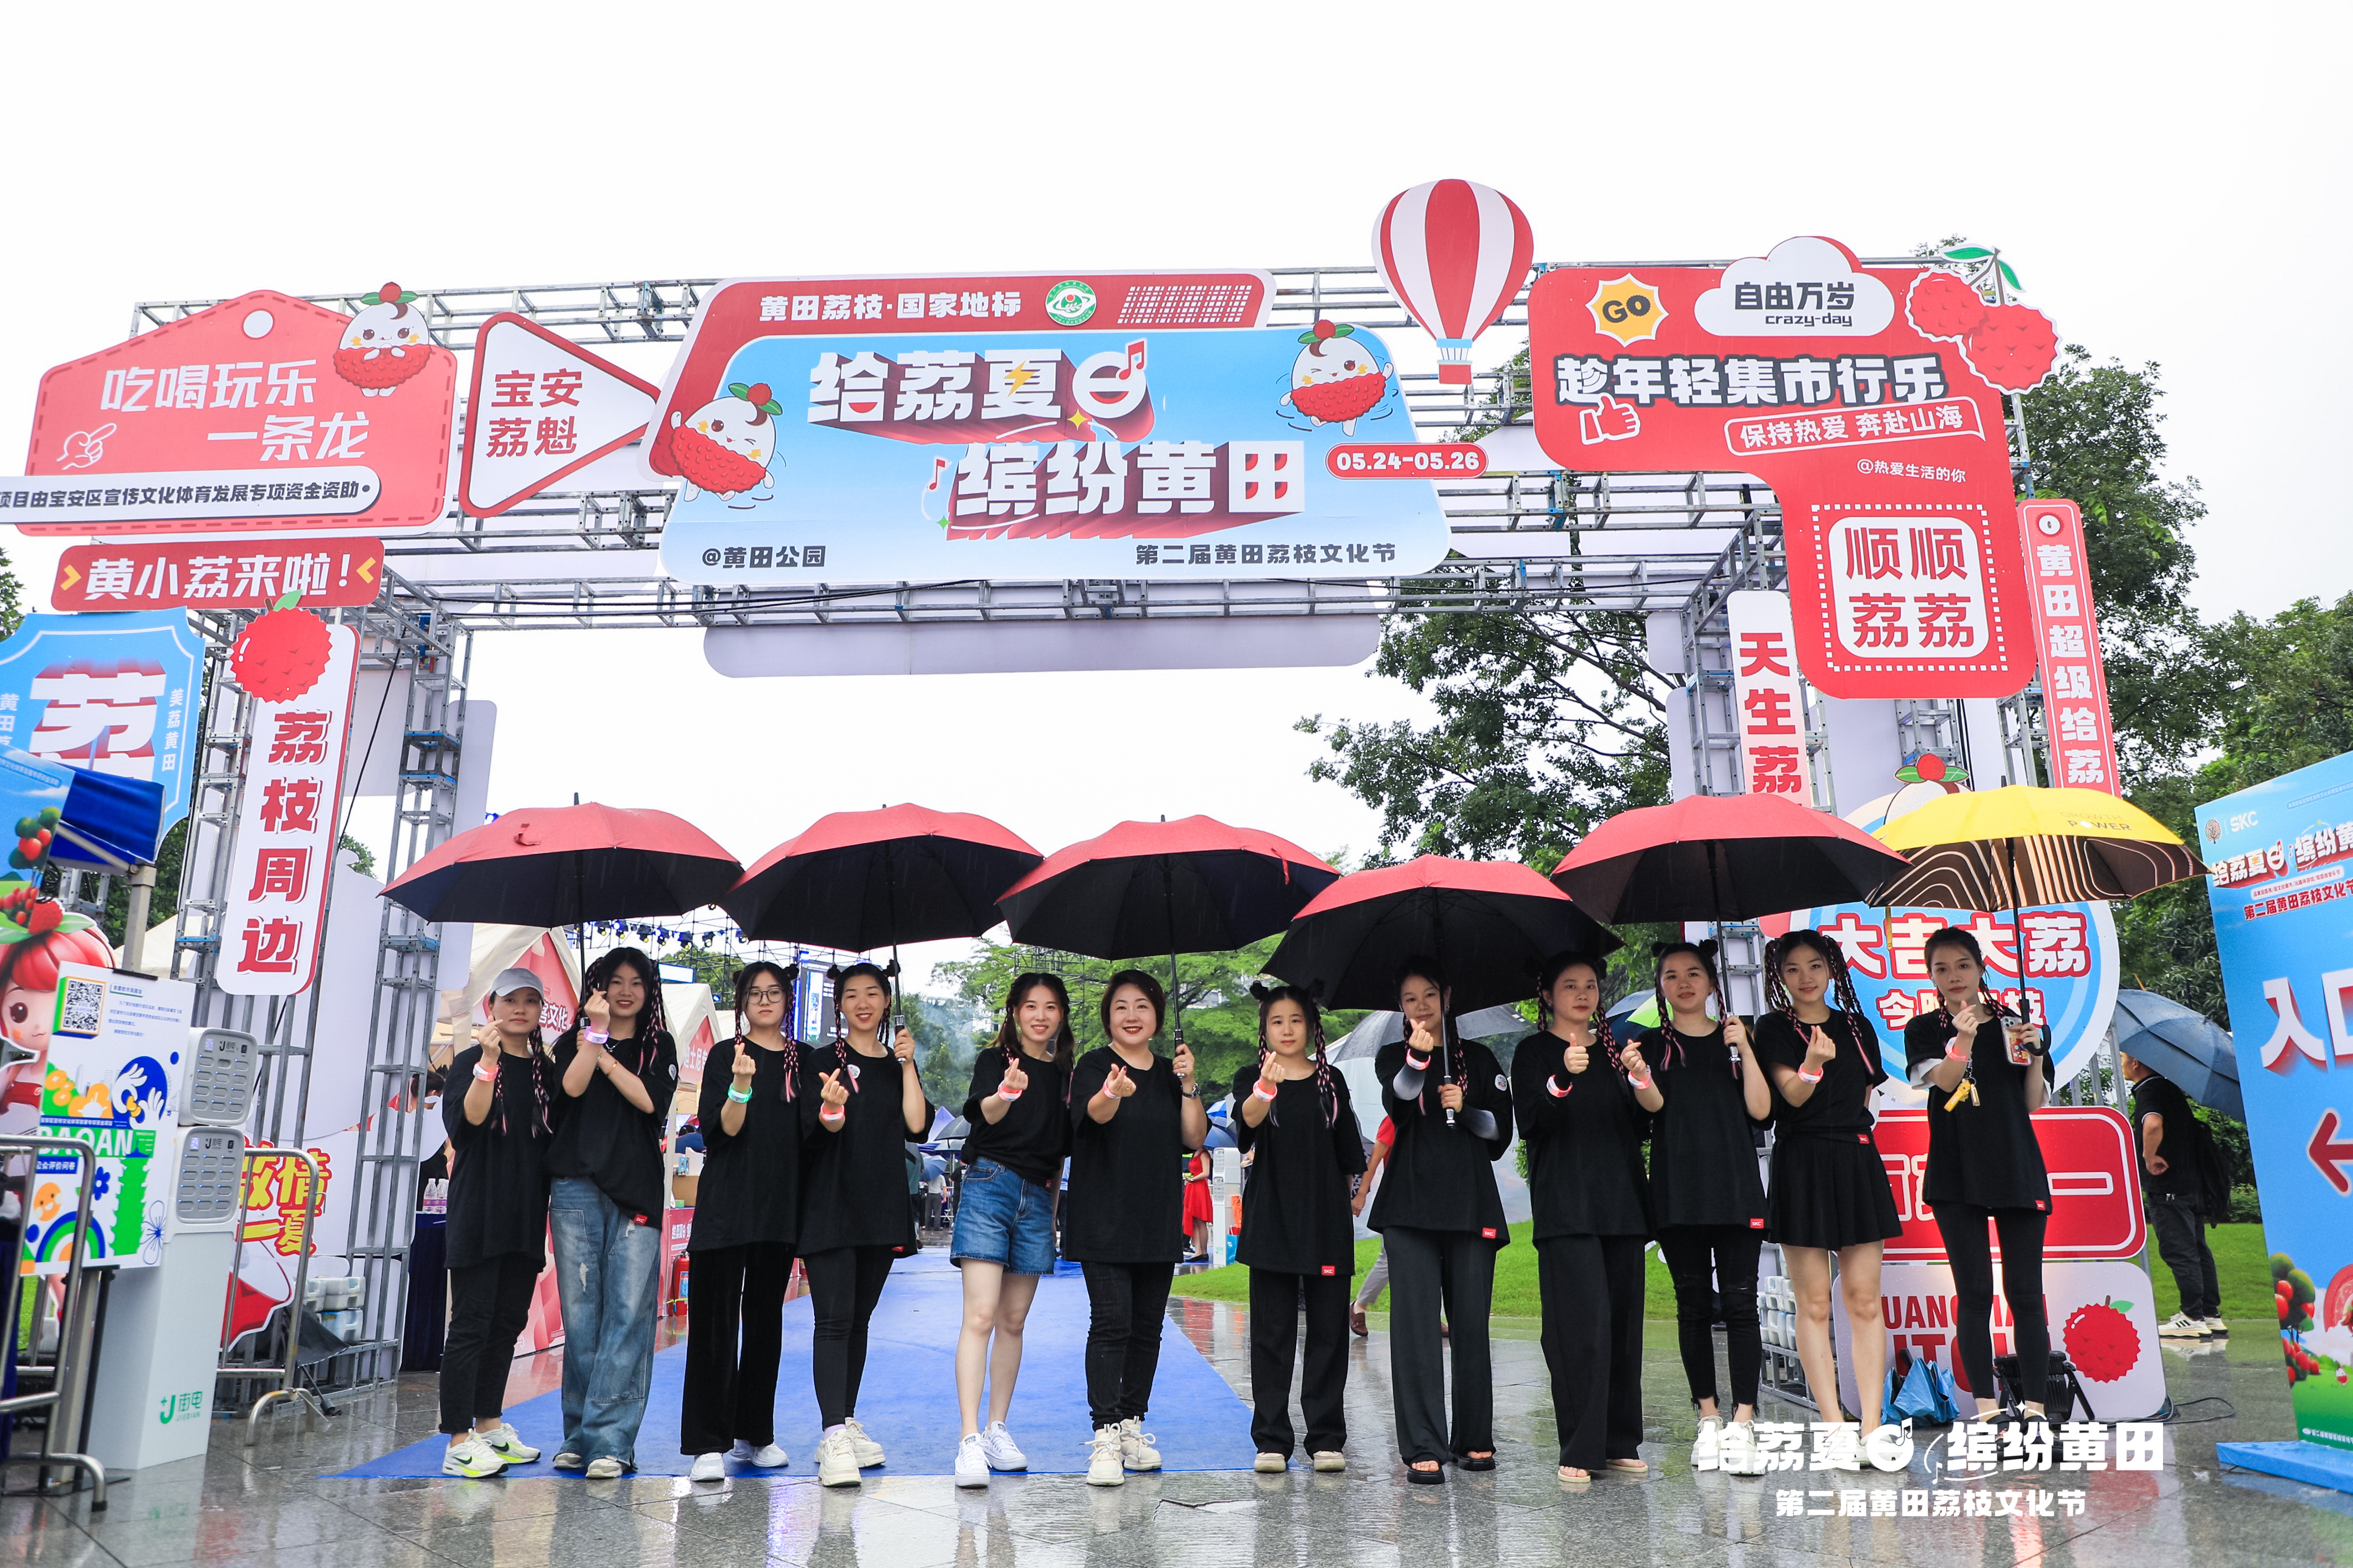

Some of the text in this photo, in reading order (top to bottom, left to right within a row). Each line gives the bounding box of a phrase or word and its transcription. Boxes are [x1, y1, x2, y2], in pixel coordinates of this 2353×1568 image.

[759, 291, 1022, 322] 黄田荔枝·国家地标
[1602, 295, 1651, 323] GO
[1735, 282, 1855, 311] 自由万岁
[1765, 313, 1852, 327] crazy-day
[100, 359, 317, 412] 吃喝玩乐
[491, 368, 583, 408] 宝安
[1557, 355, 1947, 405] 趁年轻集市行乐
[207, 411, 369, 462] 一条龙
[486, 416, 577, 458] 荔魁
[1740, 405, 1963, 448] 保持热爱 奔赴山海
[955, 440, 1305, 516] 缤纷黄田
[1335, 452, 1480, 472] 05.24-05.26
[1857, 458, 1966, 483] @热爱生活的你
[702, 546, 826, 569] @黄田公园
[1135, 543, 1397, 565] 第二届黄田荔枝文化节
[1844, 526, 1968, 581] 顺顺
[1849, 592, 1974, 649] 荔荔
[2036, 543, 2105, 785] 黄田超级给荔
[162, 688, 184, 772] 美荔黄田
[1739, 632, 1802, 807] 天生荔
[2060, 812, 2123, 820] GROWTH
[2067, 820, 2132, 830] POWER
[2230, 811, 2258, 832] SKC
[237, 710, 333, 975] 荔枝周边
